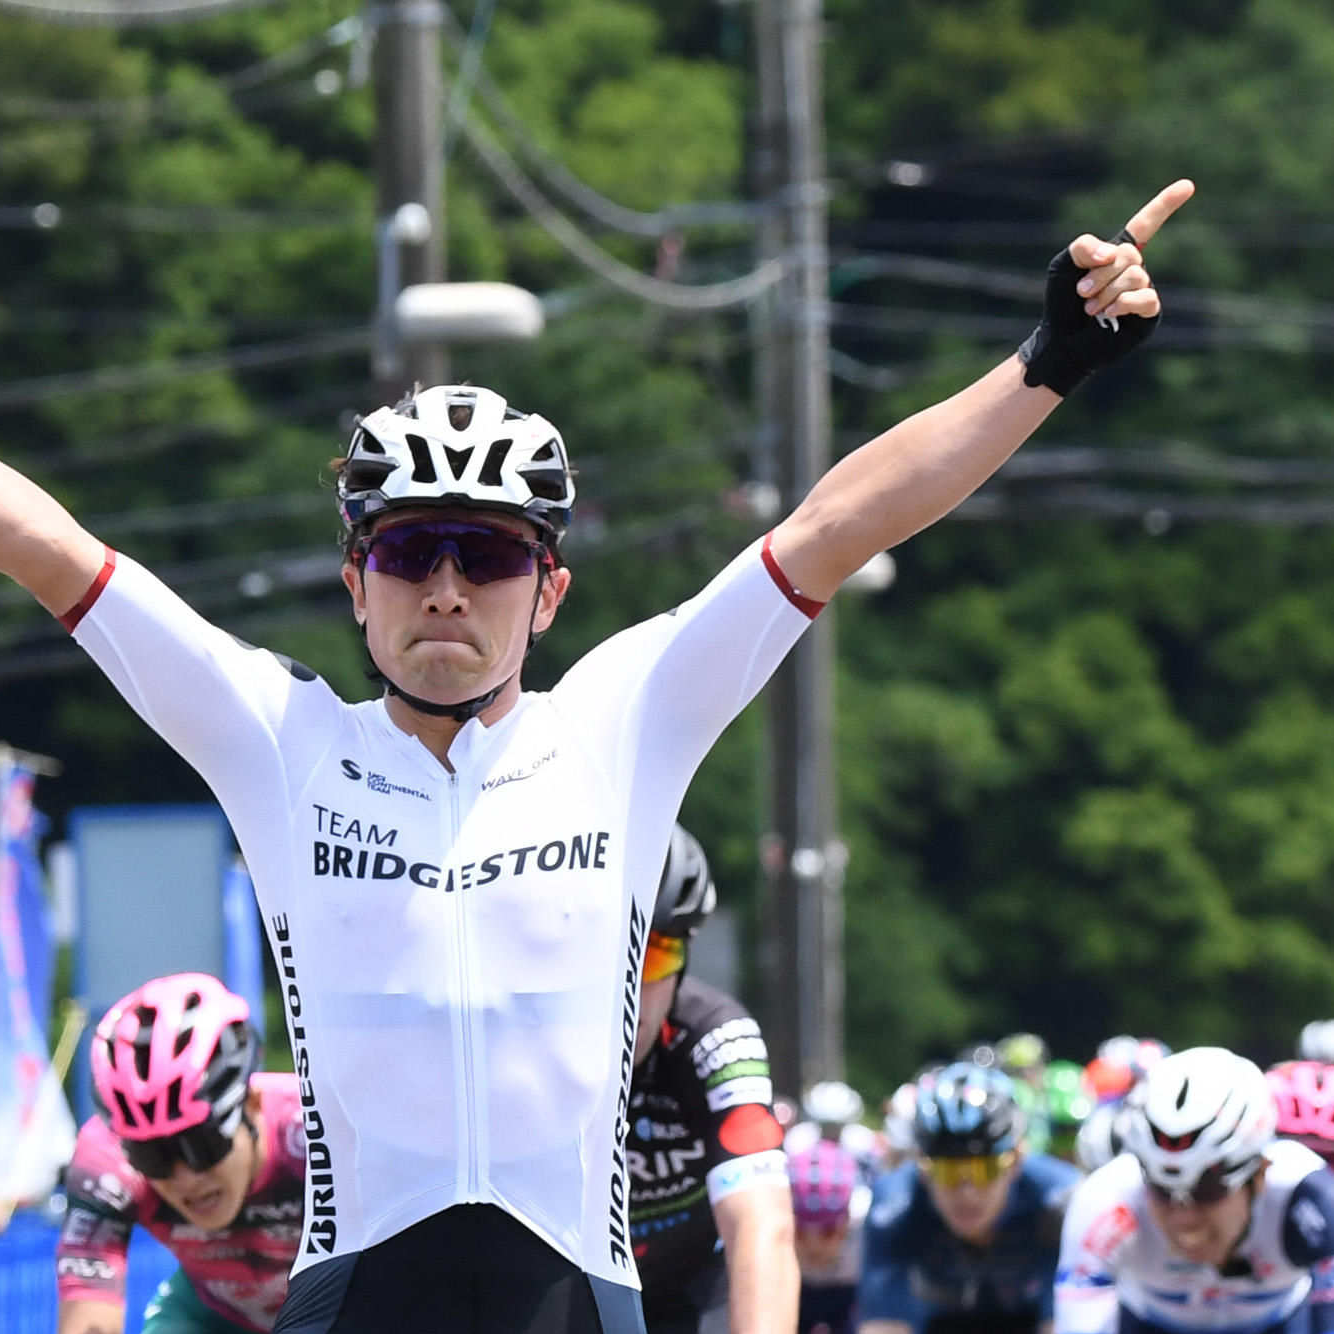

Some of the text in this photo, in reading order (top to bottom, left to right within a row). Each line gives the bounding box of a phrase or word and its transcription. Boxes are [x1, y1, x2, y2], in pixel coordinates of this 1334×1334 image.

[366, 776, 432, 802] CONTINENTAL
[312, 803, 399, 848] TEAM
[313, 831, 610, 893] BRIDGESTONE
[272, 911, 338, 1256] BRIDGESTONE
